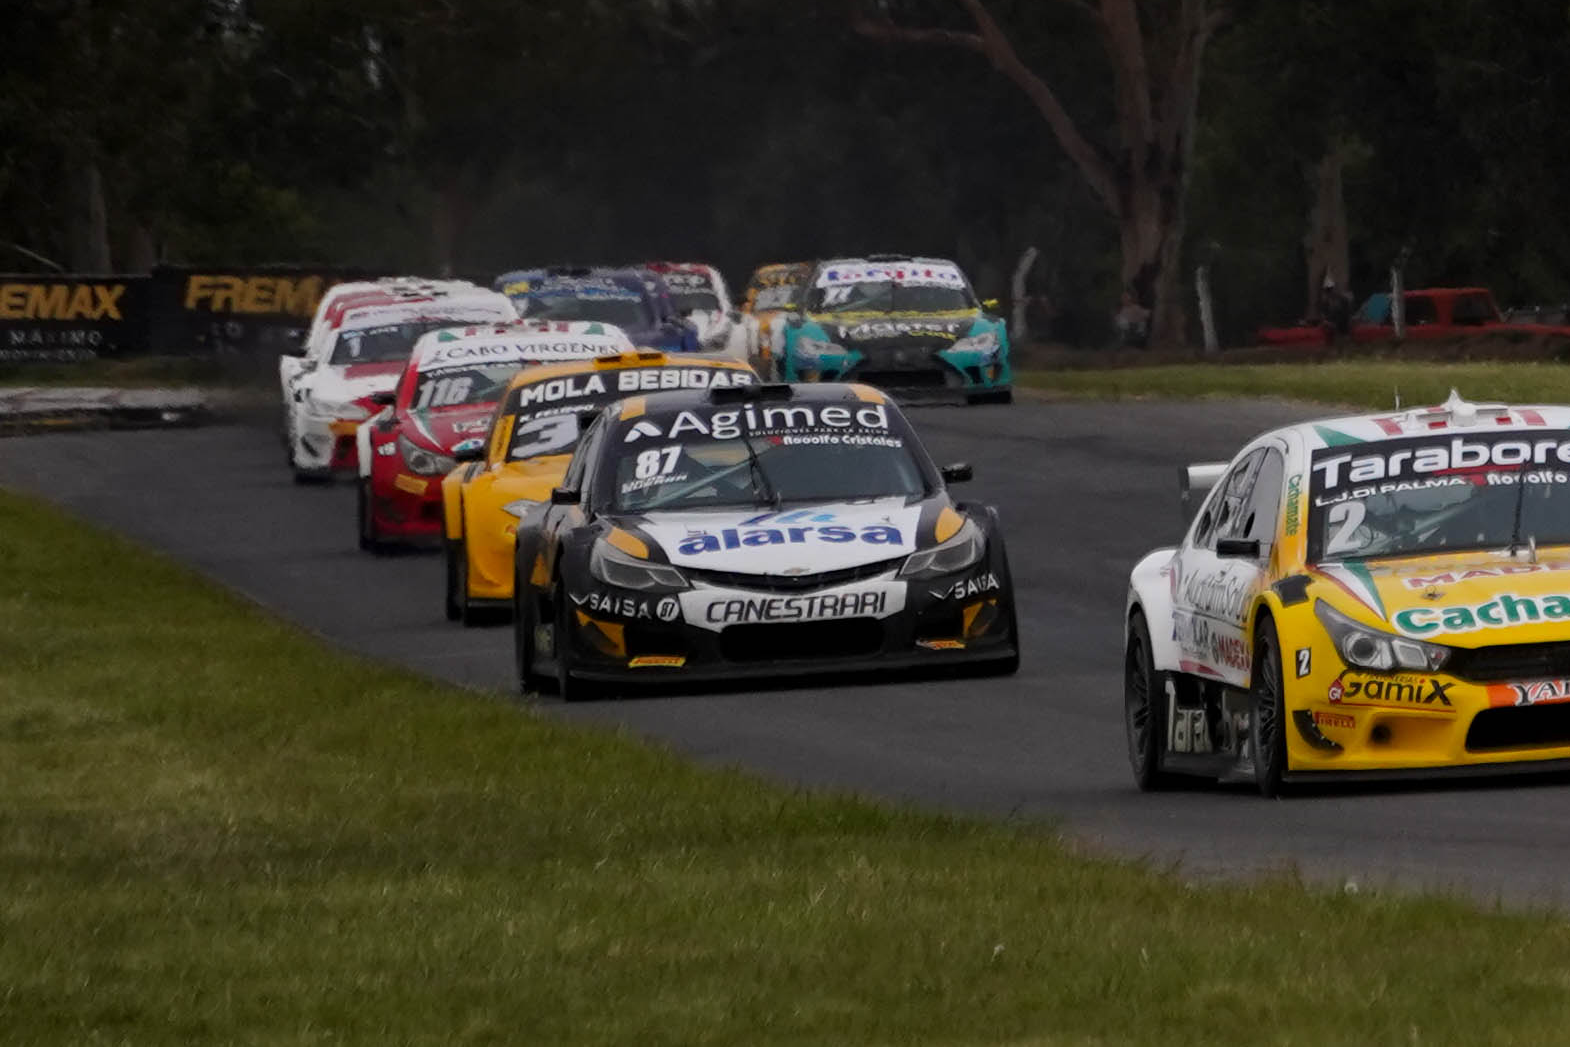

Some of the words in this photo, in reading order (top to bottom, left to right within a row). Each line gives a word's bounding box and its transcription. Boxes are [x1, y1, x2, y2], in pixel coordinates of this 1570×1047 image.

[446, 344, 509, 359] CABO
[519, 374, 607, 407] MOLA
[617, 368, 753, 392] BEBIDAS
[510, 413, 579, 458] 3
[667, 403, 889, 440] Agimed
[841, 434, 902, 449] Cristales
[635, 444, 682, 480] 87
[1379, 476, 1466, 496] PALMA
[1326, 501, 1367, 555] 2
[588, 592, 653, 620] SAISA
[705, 590, 887, 624] CANESTRARI
[1298, 649, 1311, 676] 2
